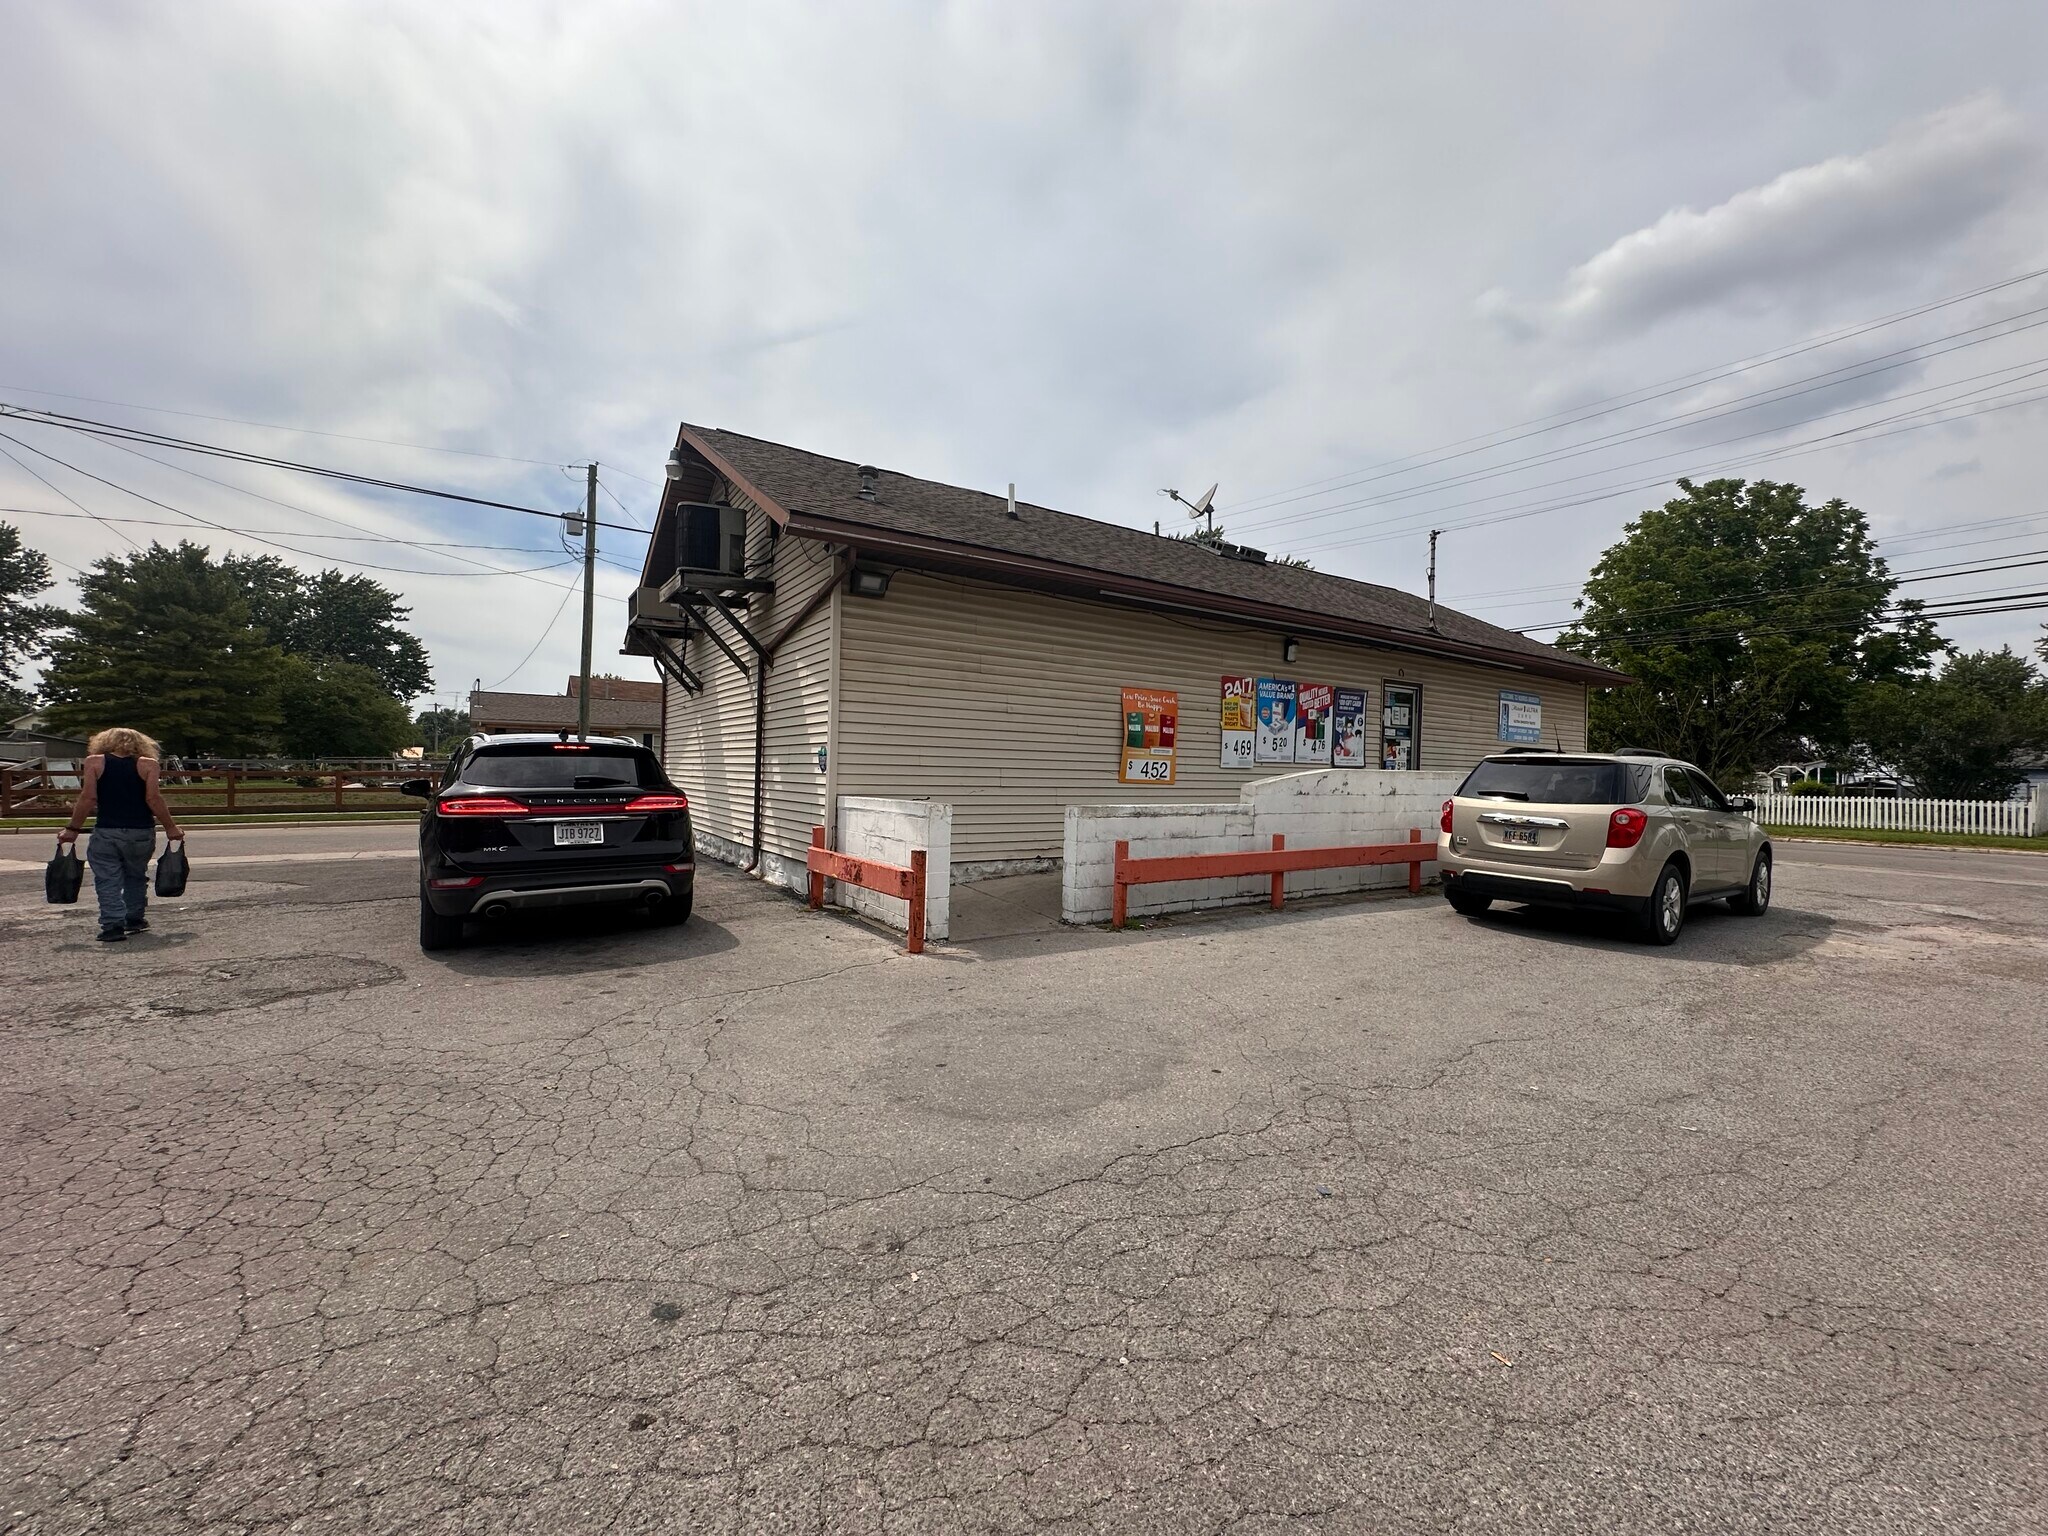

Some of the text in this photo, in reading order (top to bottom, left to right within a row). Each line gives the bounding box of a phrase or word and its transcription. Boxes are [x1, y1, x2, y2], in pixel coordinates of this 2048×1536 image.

[1123, 692, 1134, 700] Low
[1259, 690, 1276, 699] VALUE
[1276, 691, 1296, 700] BRAND
[1299, 687, 1319, 704] QUALITY
[1313, 693, 1331, 709] BETTER
[1263, 736, 1267, 744] $
[1128, 761, 1168, 779] $ 4.52
[558, 827, 600, 840] JIB 9727
